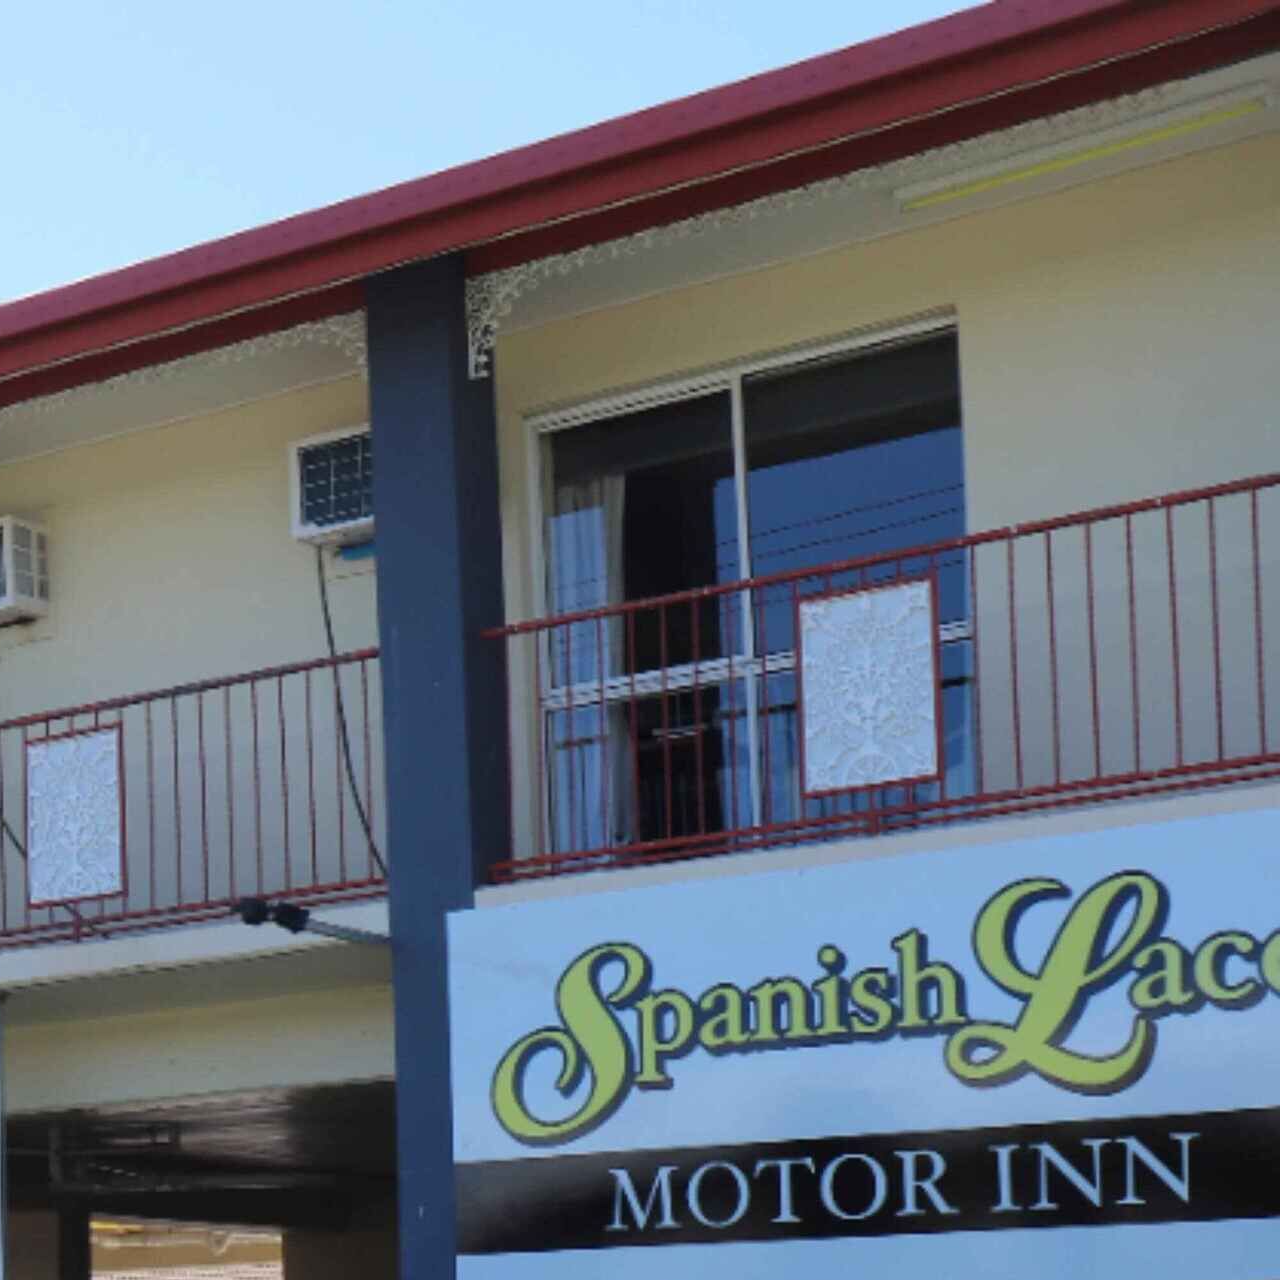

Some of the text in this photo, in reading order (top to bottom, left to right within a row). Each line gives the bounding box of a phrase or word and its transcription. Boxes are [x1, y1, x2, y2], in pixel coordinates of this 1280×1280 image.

[490, 869, 1280, 1146] Spanish Lac
[606, 1132, 1199, 1232] MOTOR INN
